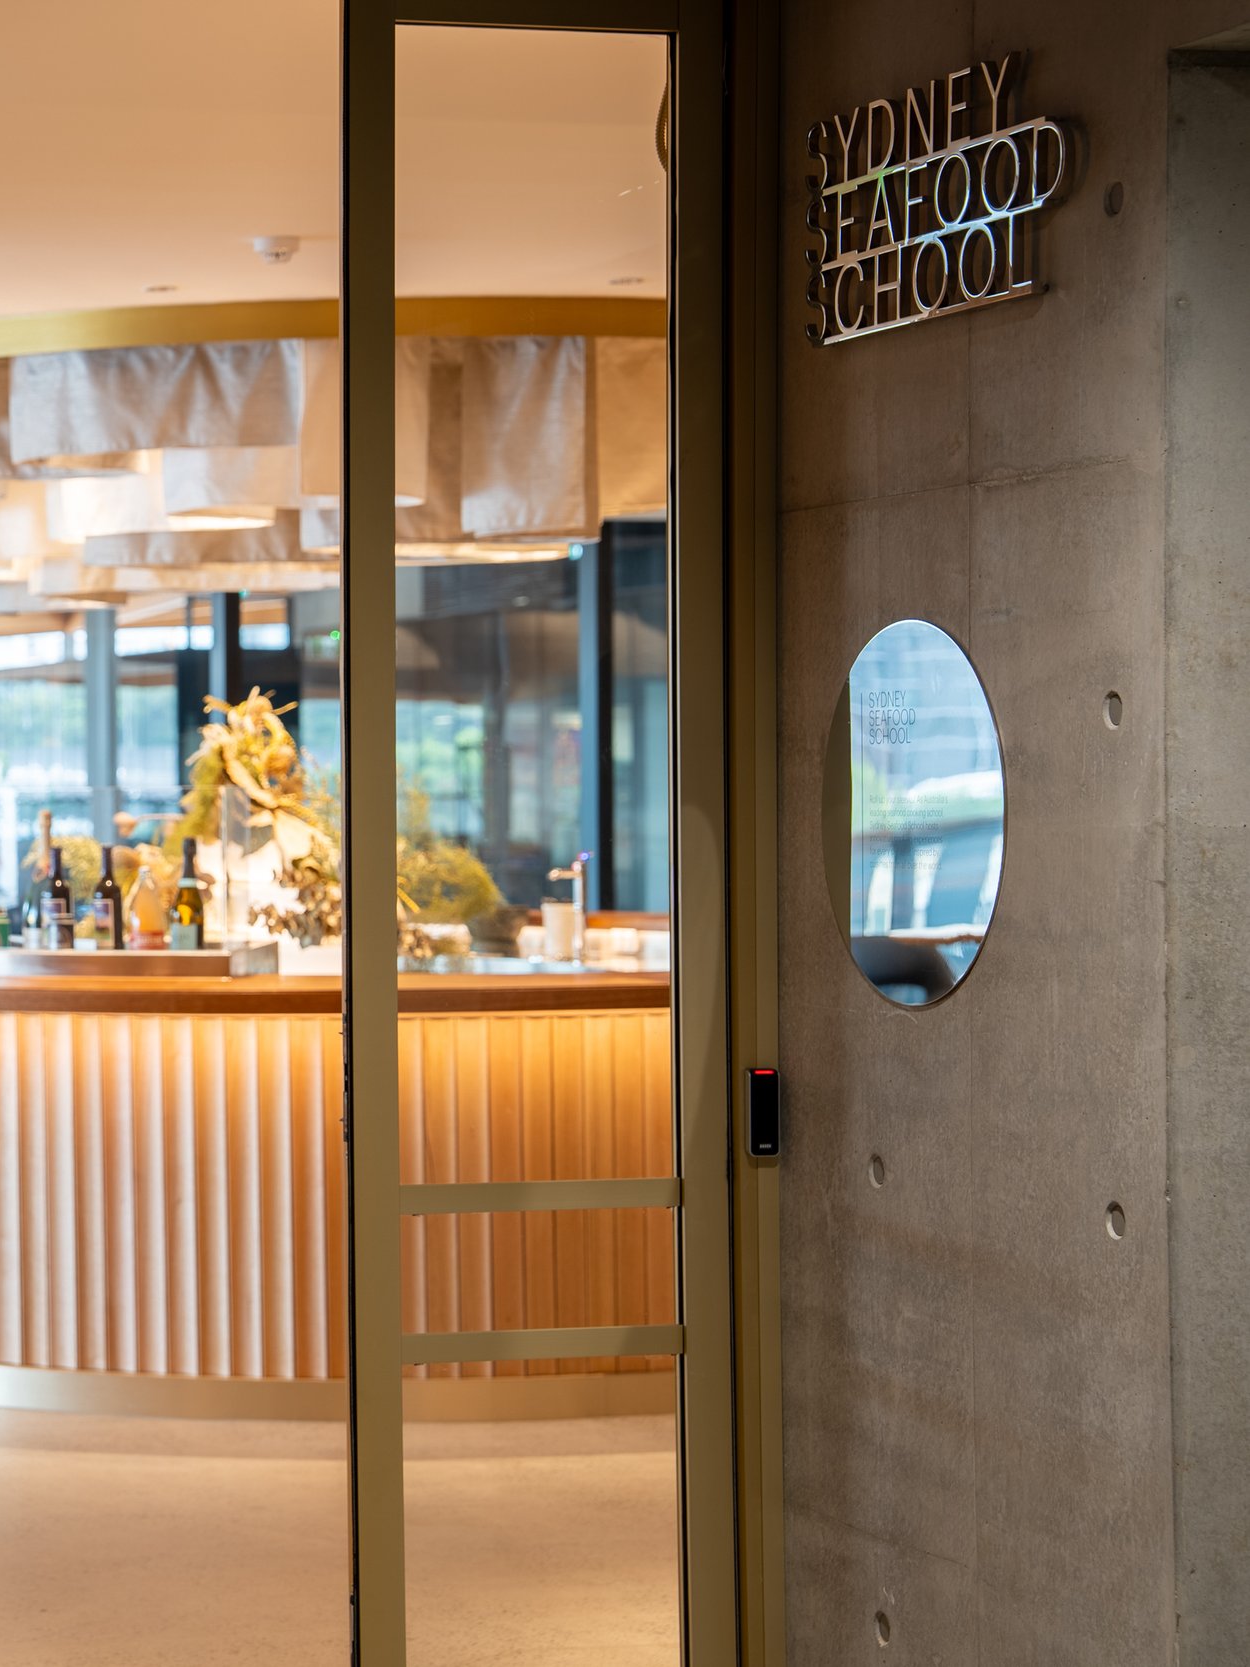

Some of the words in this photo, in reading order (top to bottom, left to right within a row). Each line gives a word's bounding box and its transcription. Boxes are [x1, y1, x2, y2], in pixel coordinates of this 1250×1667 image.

[806, 52, 1018, 195] SYDNEY
[806, 119, 1066, 269] SEAFOOD
[806, 213, 1032, 345] SCHOOL
[869, 690, 906, 708] SYDNEY
[869, 708, 916, 727] SEAFOOD
[869, 727, 911, 745] SCHOOL
